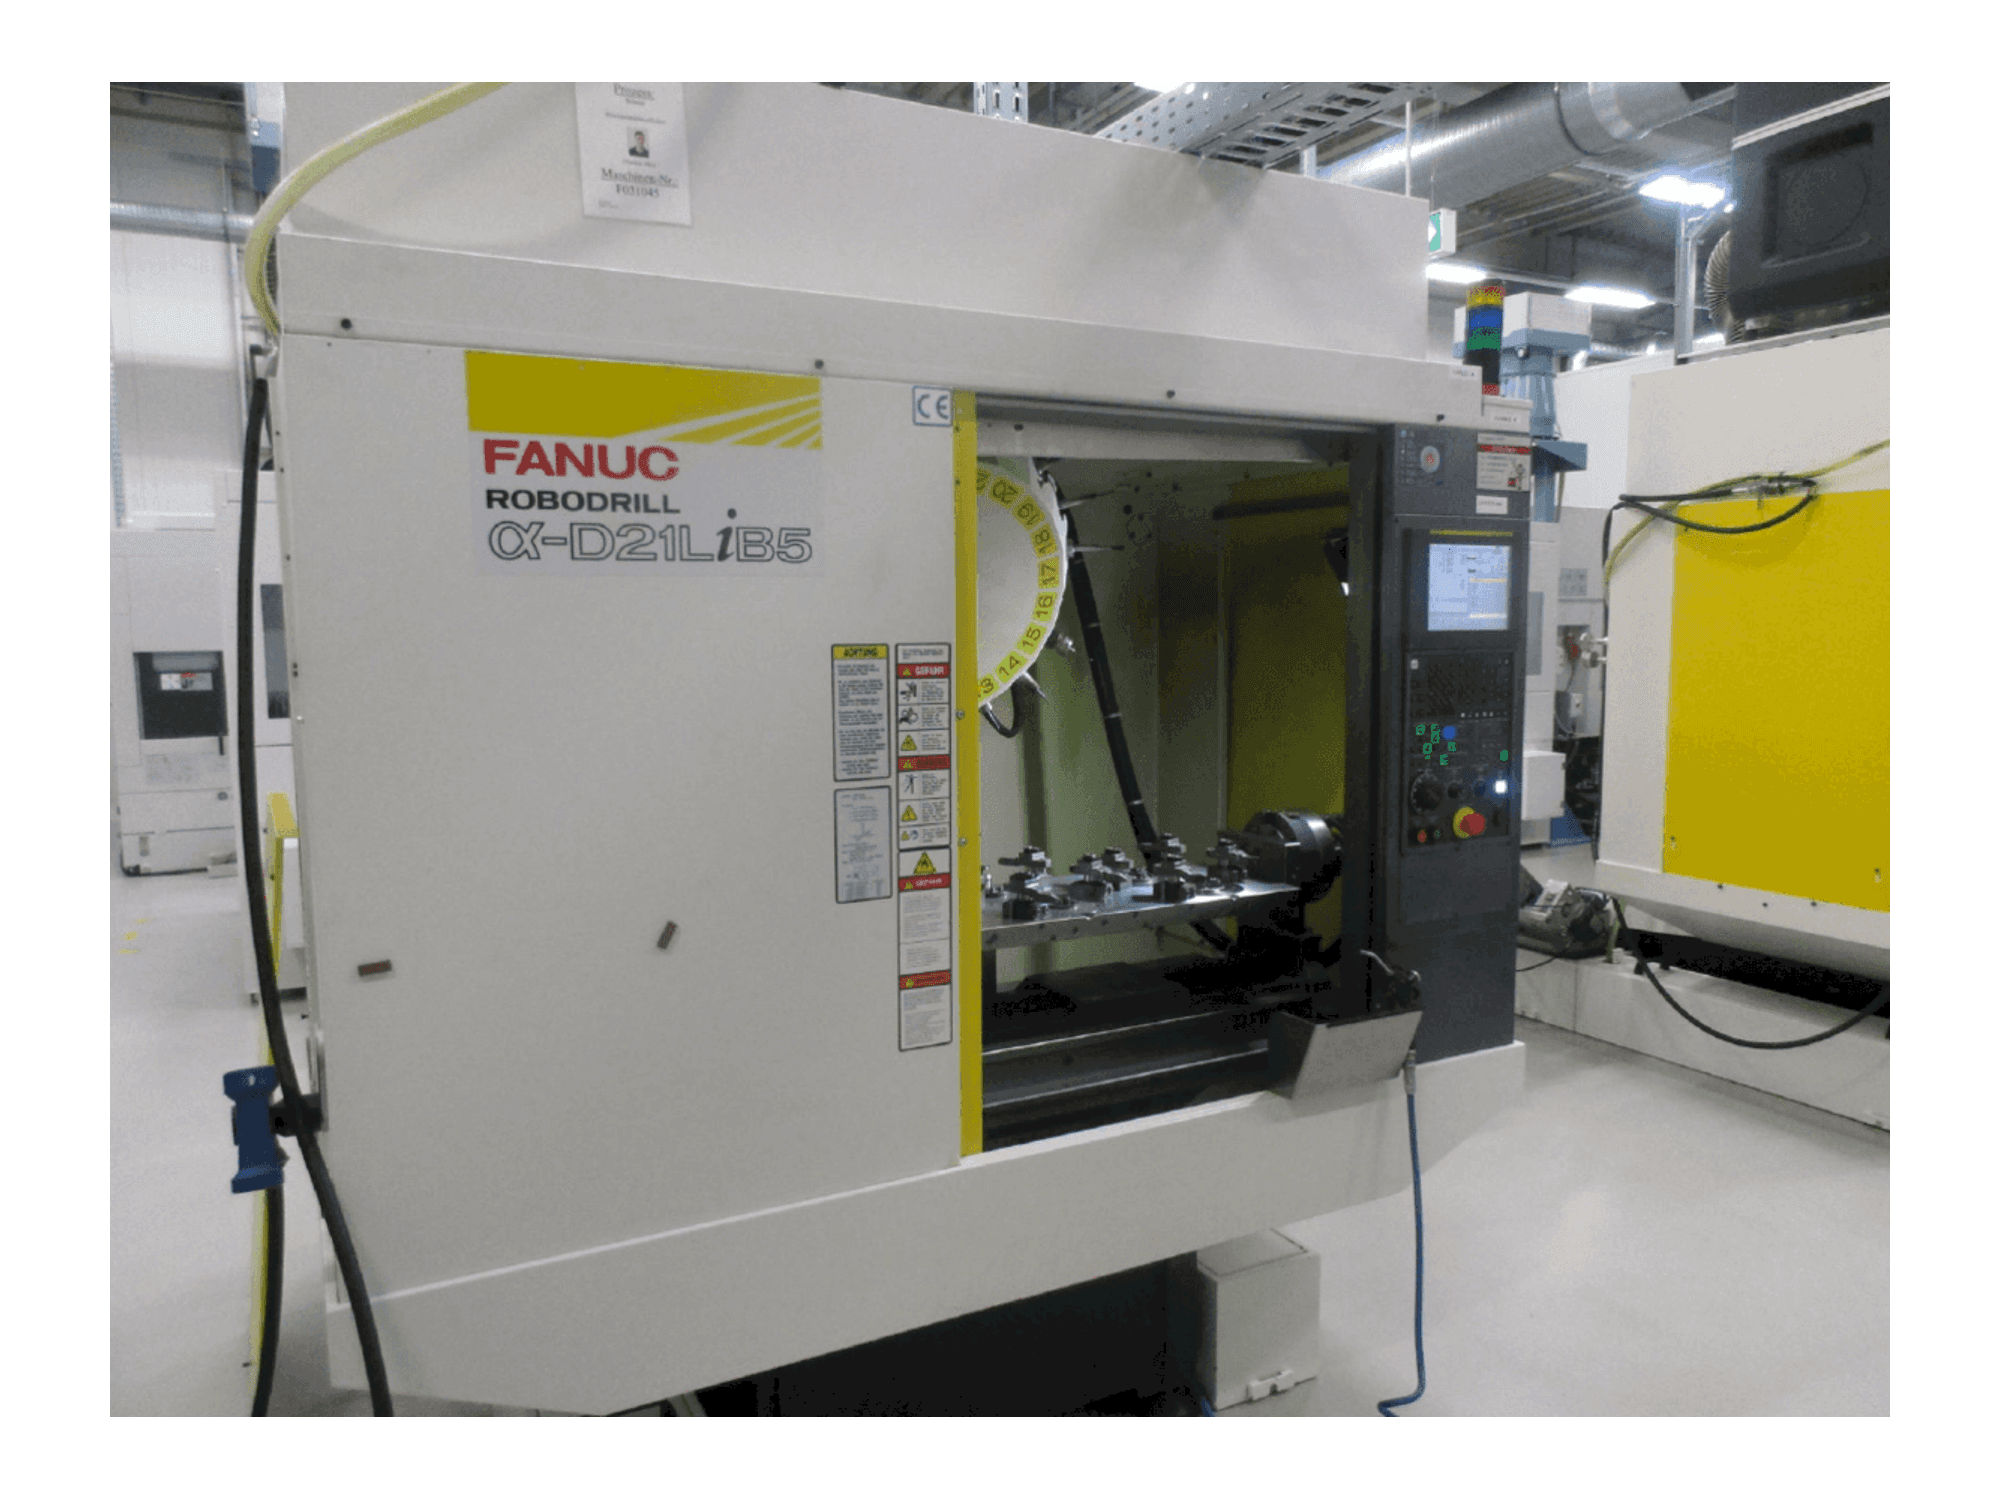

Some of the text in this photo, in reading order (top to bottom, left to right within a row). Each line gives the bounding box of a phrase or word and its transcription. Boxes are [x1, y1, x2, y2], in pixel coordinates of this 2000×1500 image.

[917, 393, 949, 420] CE
[484, 439, 679, 481] FANUC
[487, 489, 681, 513] ROBODRILL
[992, 478, 1018, 505] 20
[1016, 502, 1039, 526] 19
[1035, 528, 1053, 555] 18
[1040, 562, 1057, 586] 17
[1036, 596, 1054, 619] 16
[1022, 626, 1041, 649] 15
[999, 655, 1022, 676] 14
